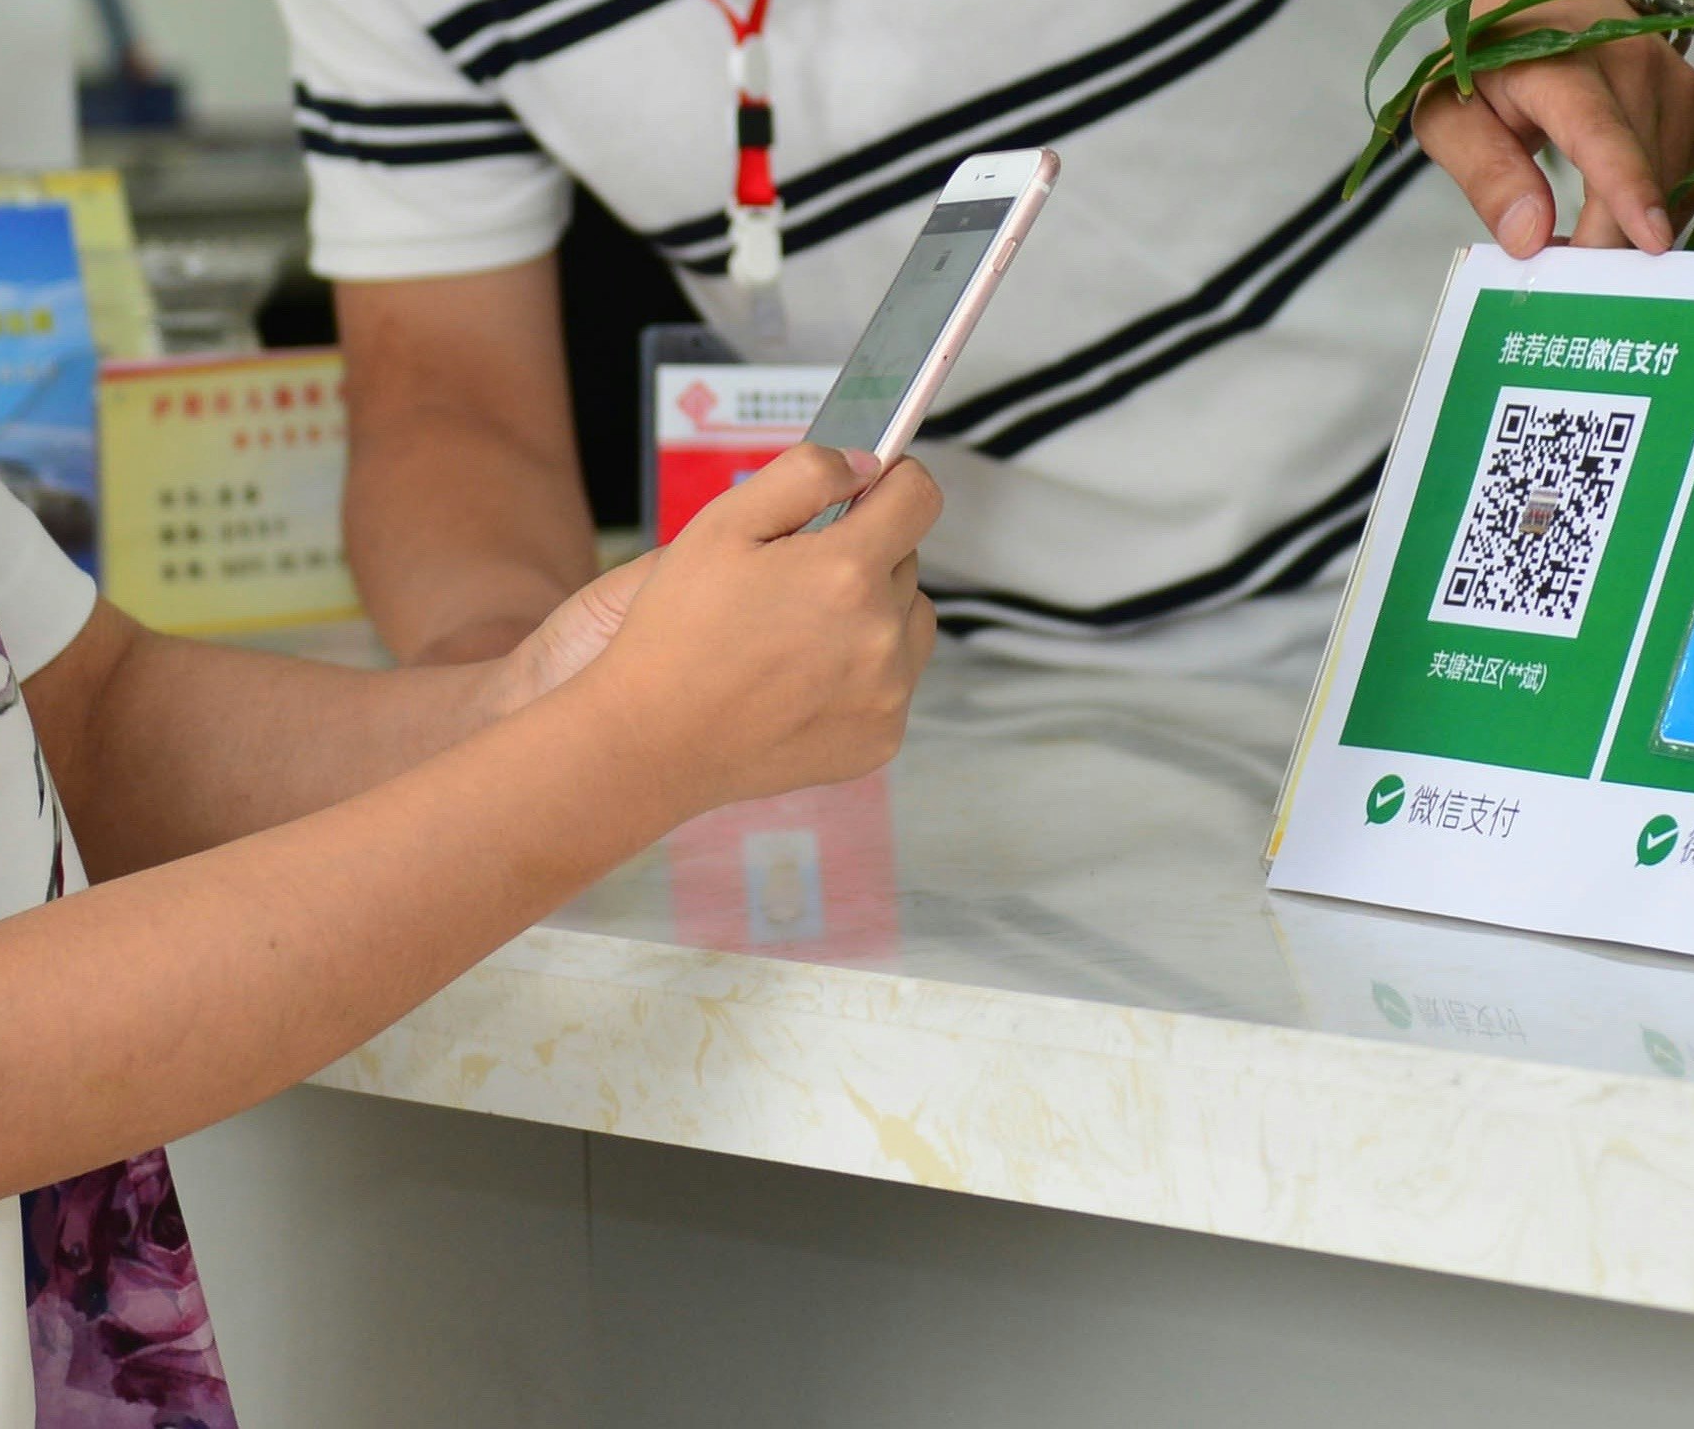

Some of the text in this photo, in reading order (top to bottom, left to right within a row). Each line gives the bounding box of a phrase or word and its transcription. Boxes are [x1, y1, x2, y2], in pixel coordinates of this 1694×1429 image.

[1498, 330, 1679, 376] 推荐使用微信支付
[1408, 784, 1520, 838] 微信支付
